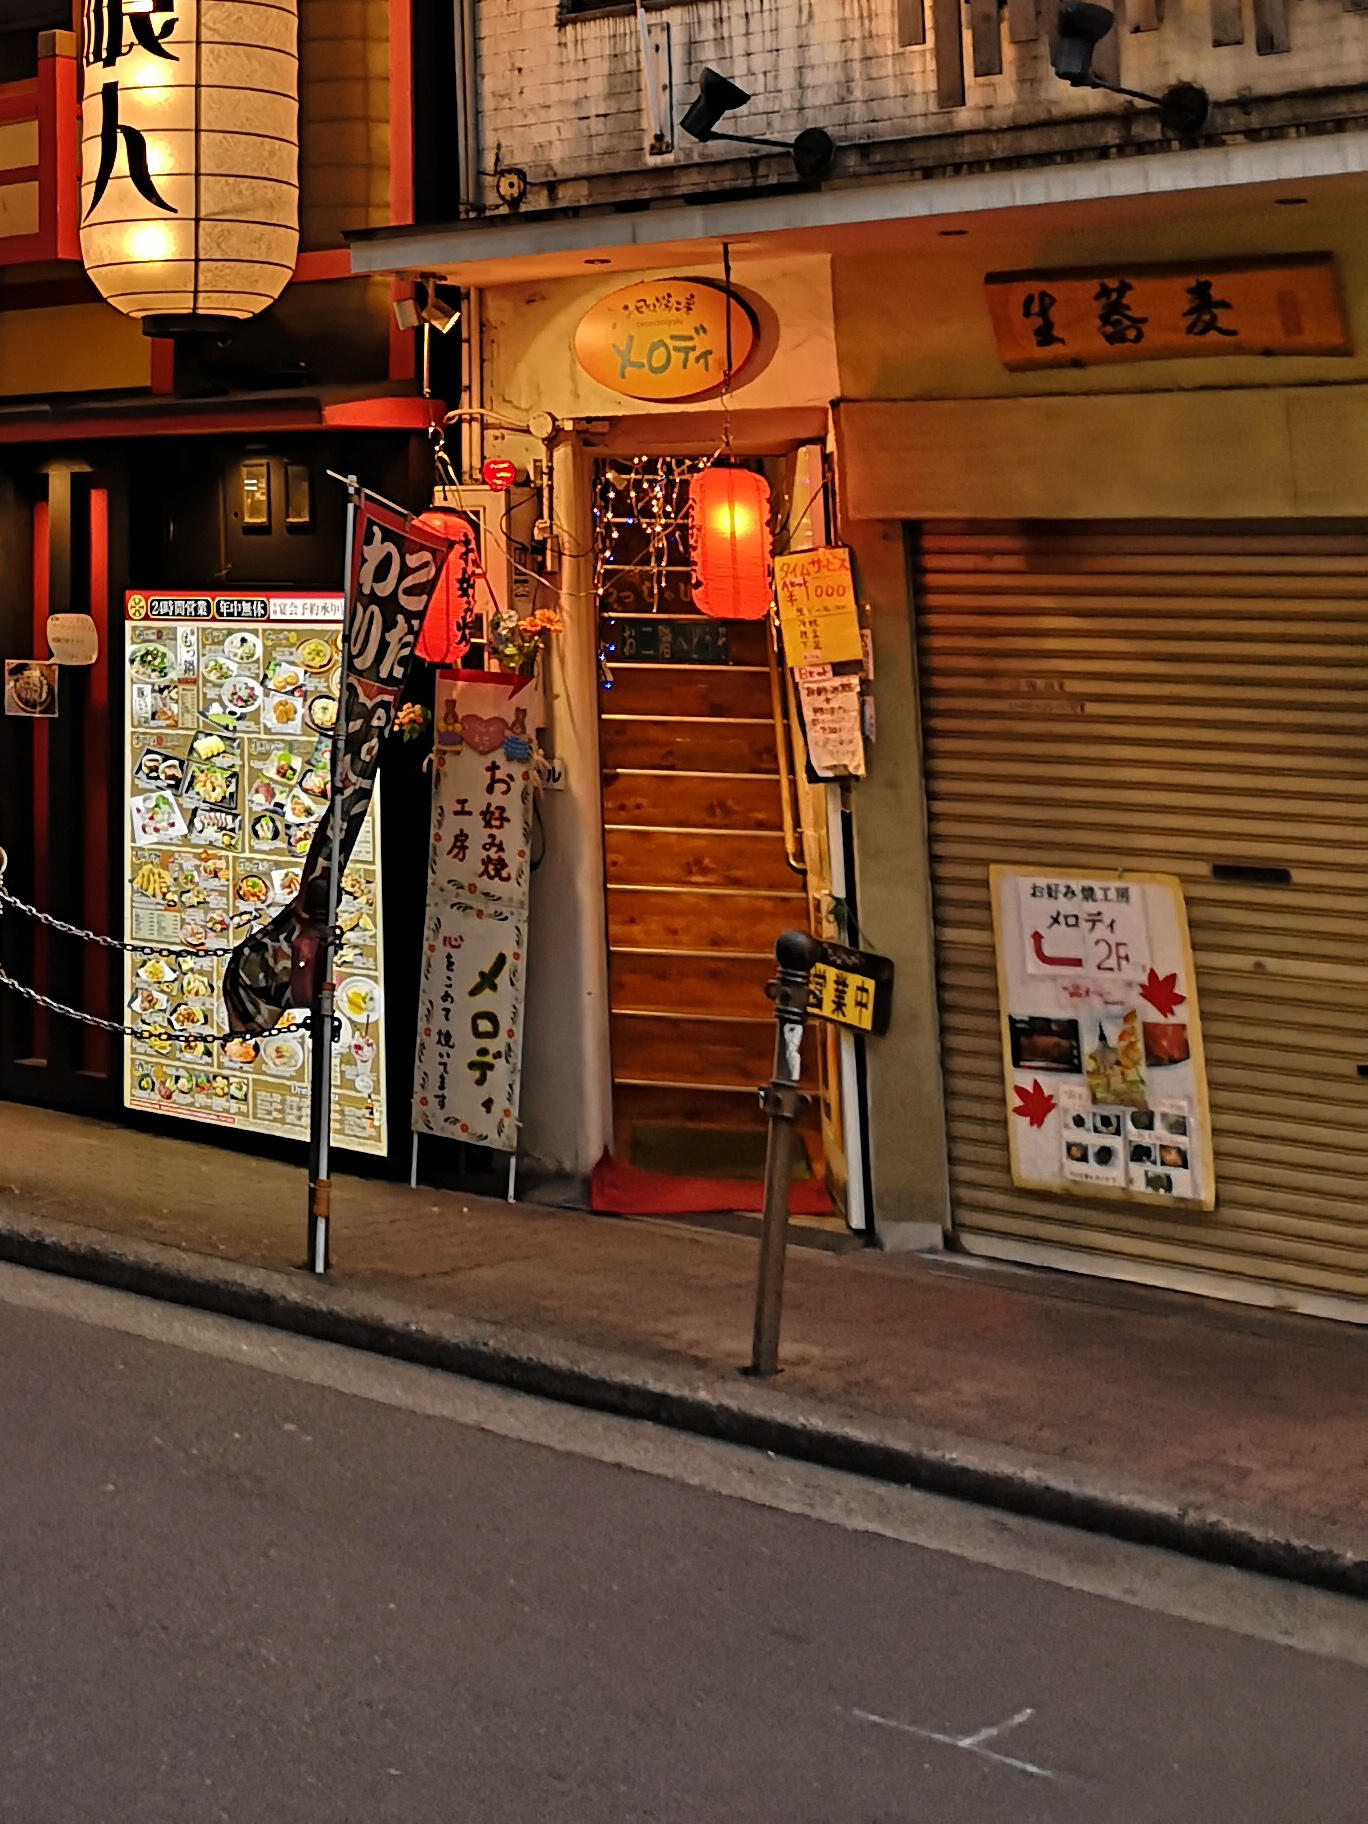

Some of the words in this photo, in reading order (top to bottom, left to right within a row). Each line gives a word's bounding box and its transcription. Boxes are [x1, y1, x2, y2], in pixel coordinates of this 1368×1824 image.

[612, 323, 713, 380] メロディ
[779, 556, 850, 579] タイムサービス
[219, 599, 265, 618] 年中無休
[446, 798, 474, 862] 工房
[479, 760, 516, 883] お好み焼
[1030, 882, 1130, 904] お好み焼工房
[1048, 910, 1117, 933] メロディ
[1094, 938, 1130, 972] 2F
[467, 951, 507, 1114] メロディ
